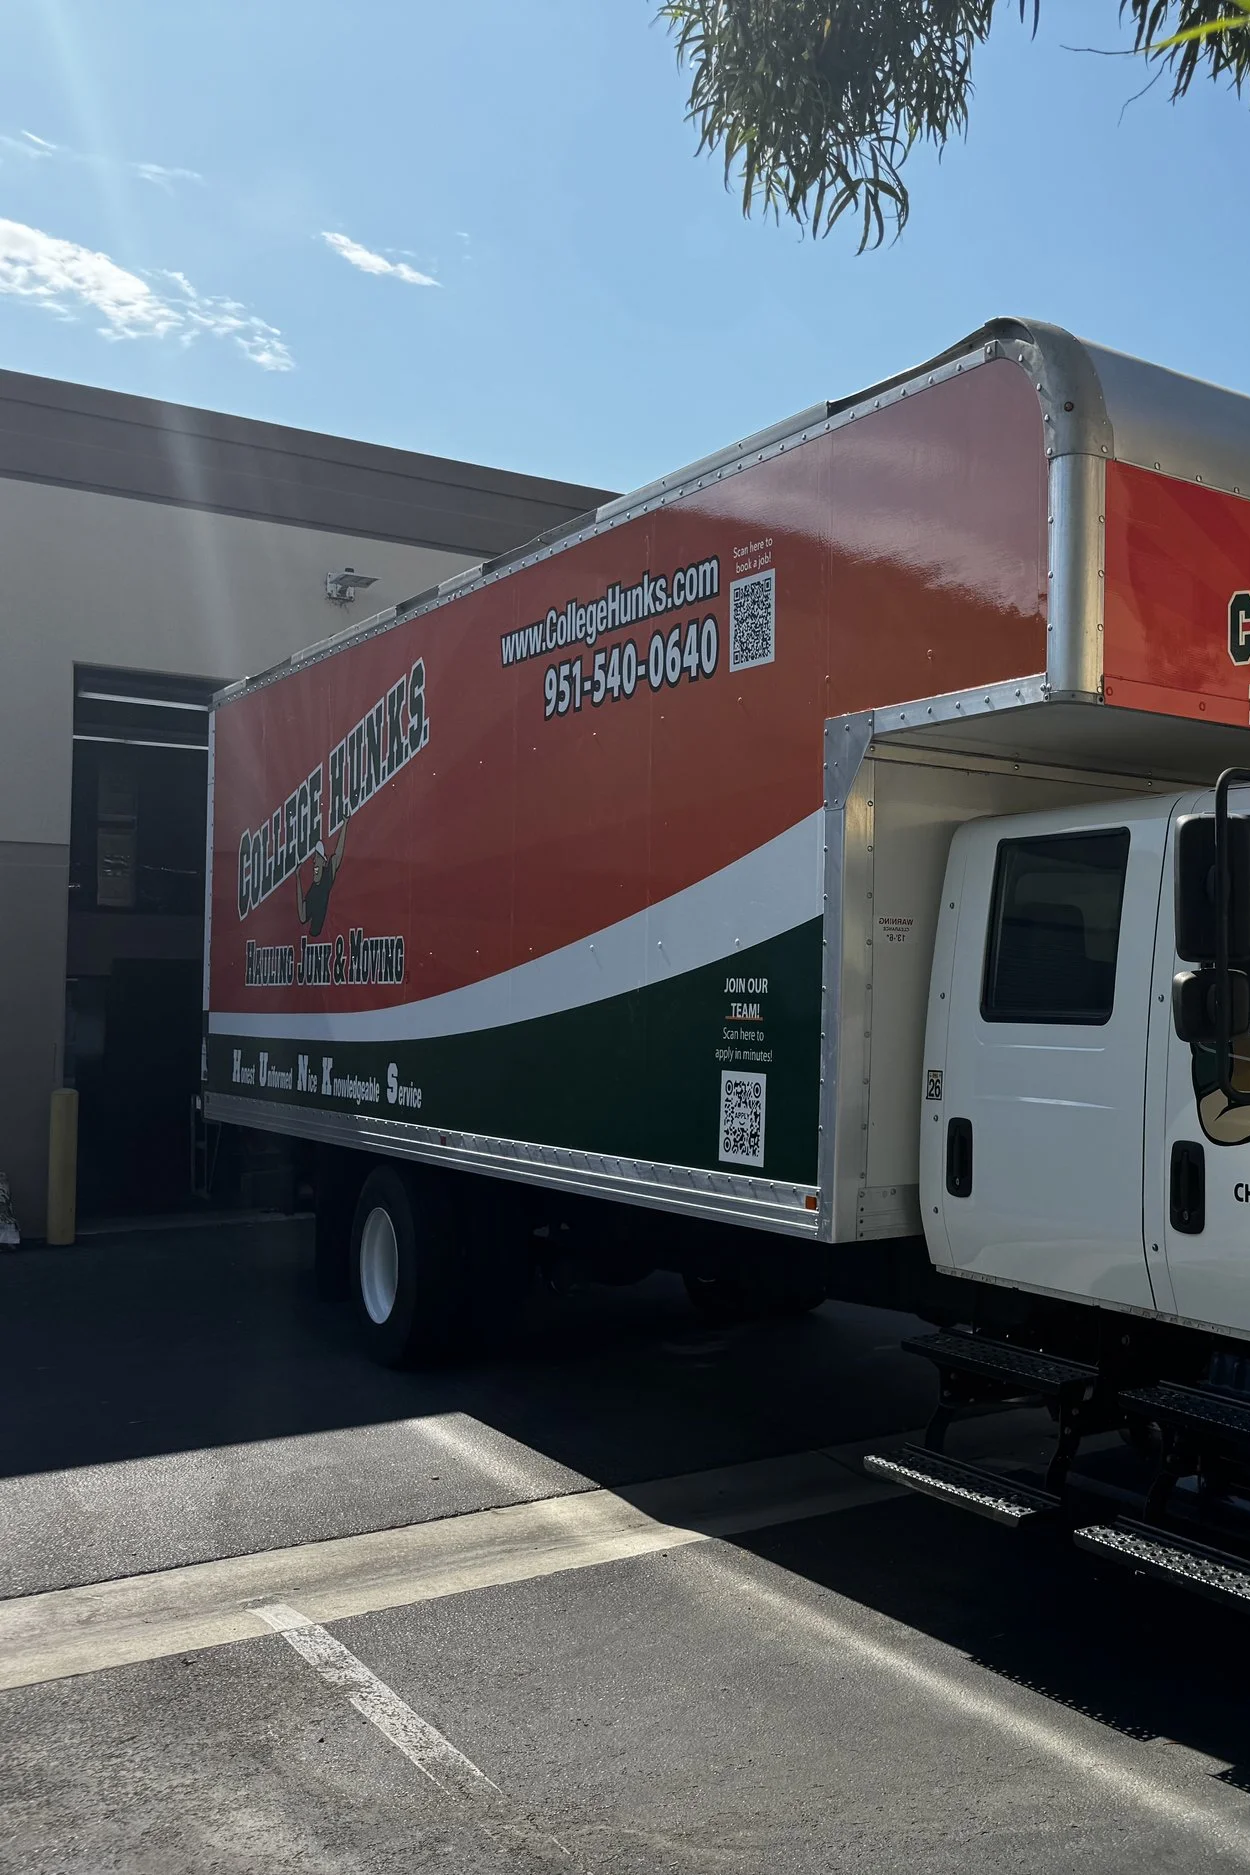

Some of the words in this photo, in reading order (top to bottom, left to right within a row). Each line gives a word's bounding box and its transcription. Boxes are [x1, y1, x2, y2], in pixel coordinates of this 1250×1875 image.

[733, 546, 749, 559] Scan
[750, 541, 764, 553] here
[765, 537, 773, 548] to
[735, 558, 752, 574] book
[752, 559, 758, 568] a
[758, 551, 772, 570] job!
[501, 557, 720, 666] www.CollegeHunks.com
[543, 616, 720, 719] 951-540-0640
[237, 762, 324, 921] COLLEGE
[245, 940, 295, 987] HAULING
[297, 936, 332, 986] JUNK
[333, 935, 346, 985] &
[348, 928, 405, 985] MOVING
[723, 977, 746, 993] JOIN
[747, 977, 768, 994] OUR
[730, 1002, 760, 1019] TEAM!
[722, 1026, 739, 1040] Scan
[740, 1026, 756, 1041] here
[756, 1029, 765, 1042] to
[714, 1046, 735, 1062] apply
[734, 1047, 742, 1060] in
[742, 1048, 773, 1063] minutes!
[232, 1049, 256, 1086] Honest
[259, 1052, 293, 1090] Uniformed
[297, 1054, 318, 1094] Nice
[321, 1057, 380, 1106] Knowledgeable
[386, 1062, 422, 1109] Service
[928, 1078, 941, 1098] 26
